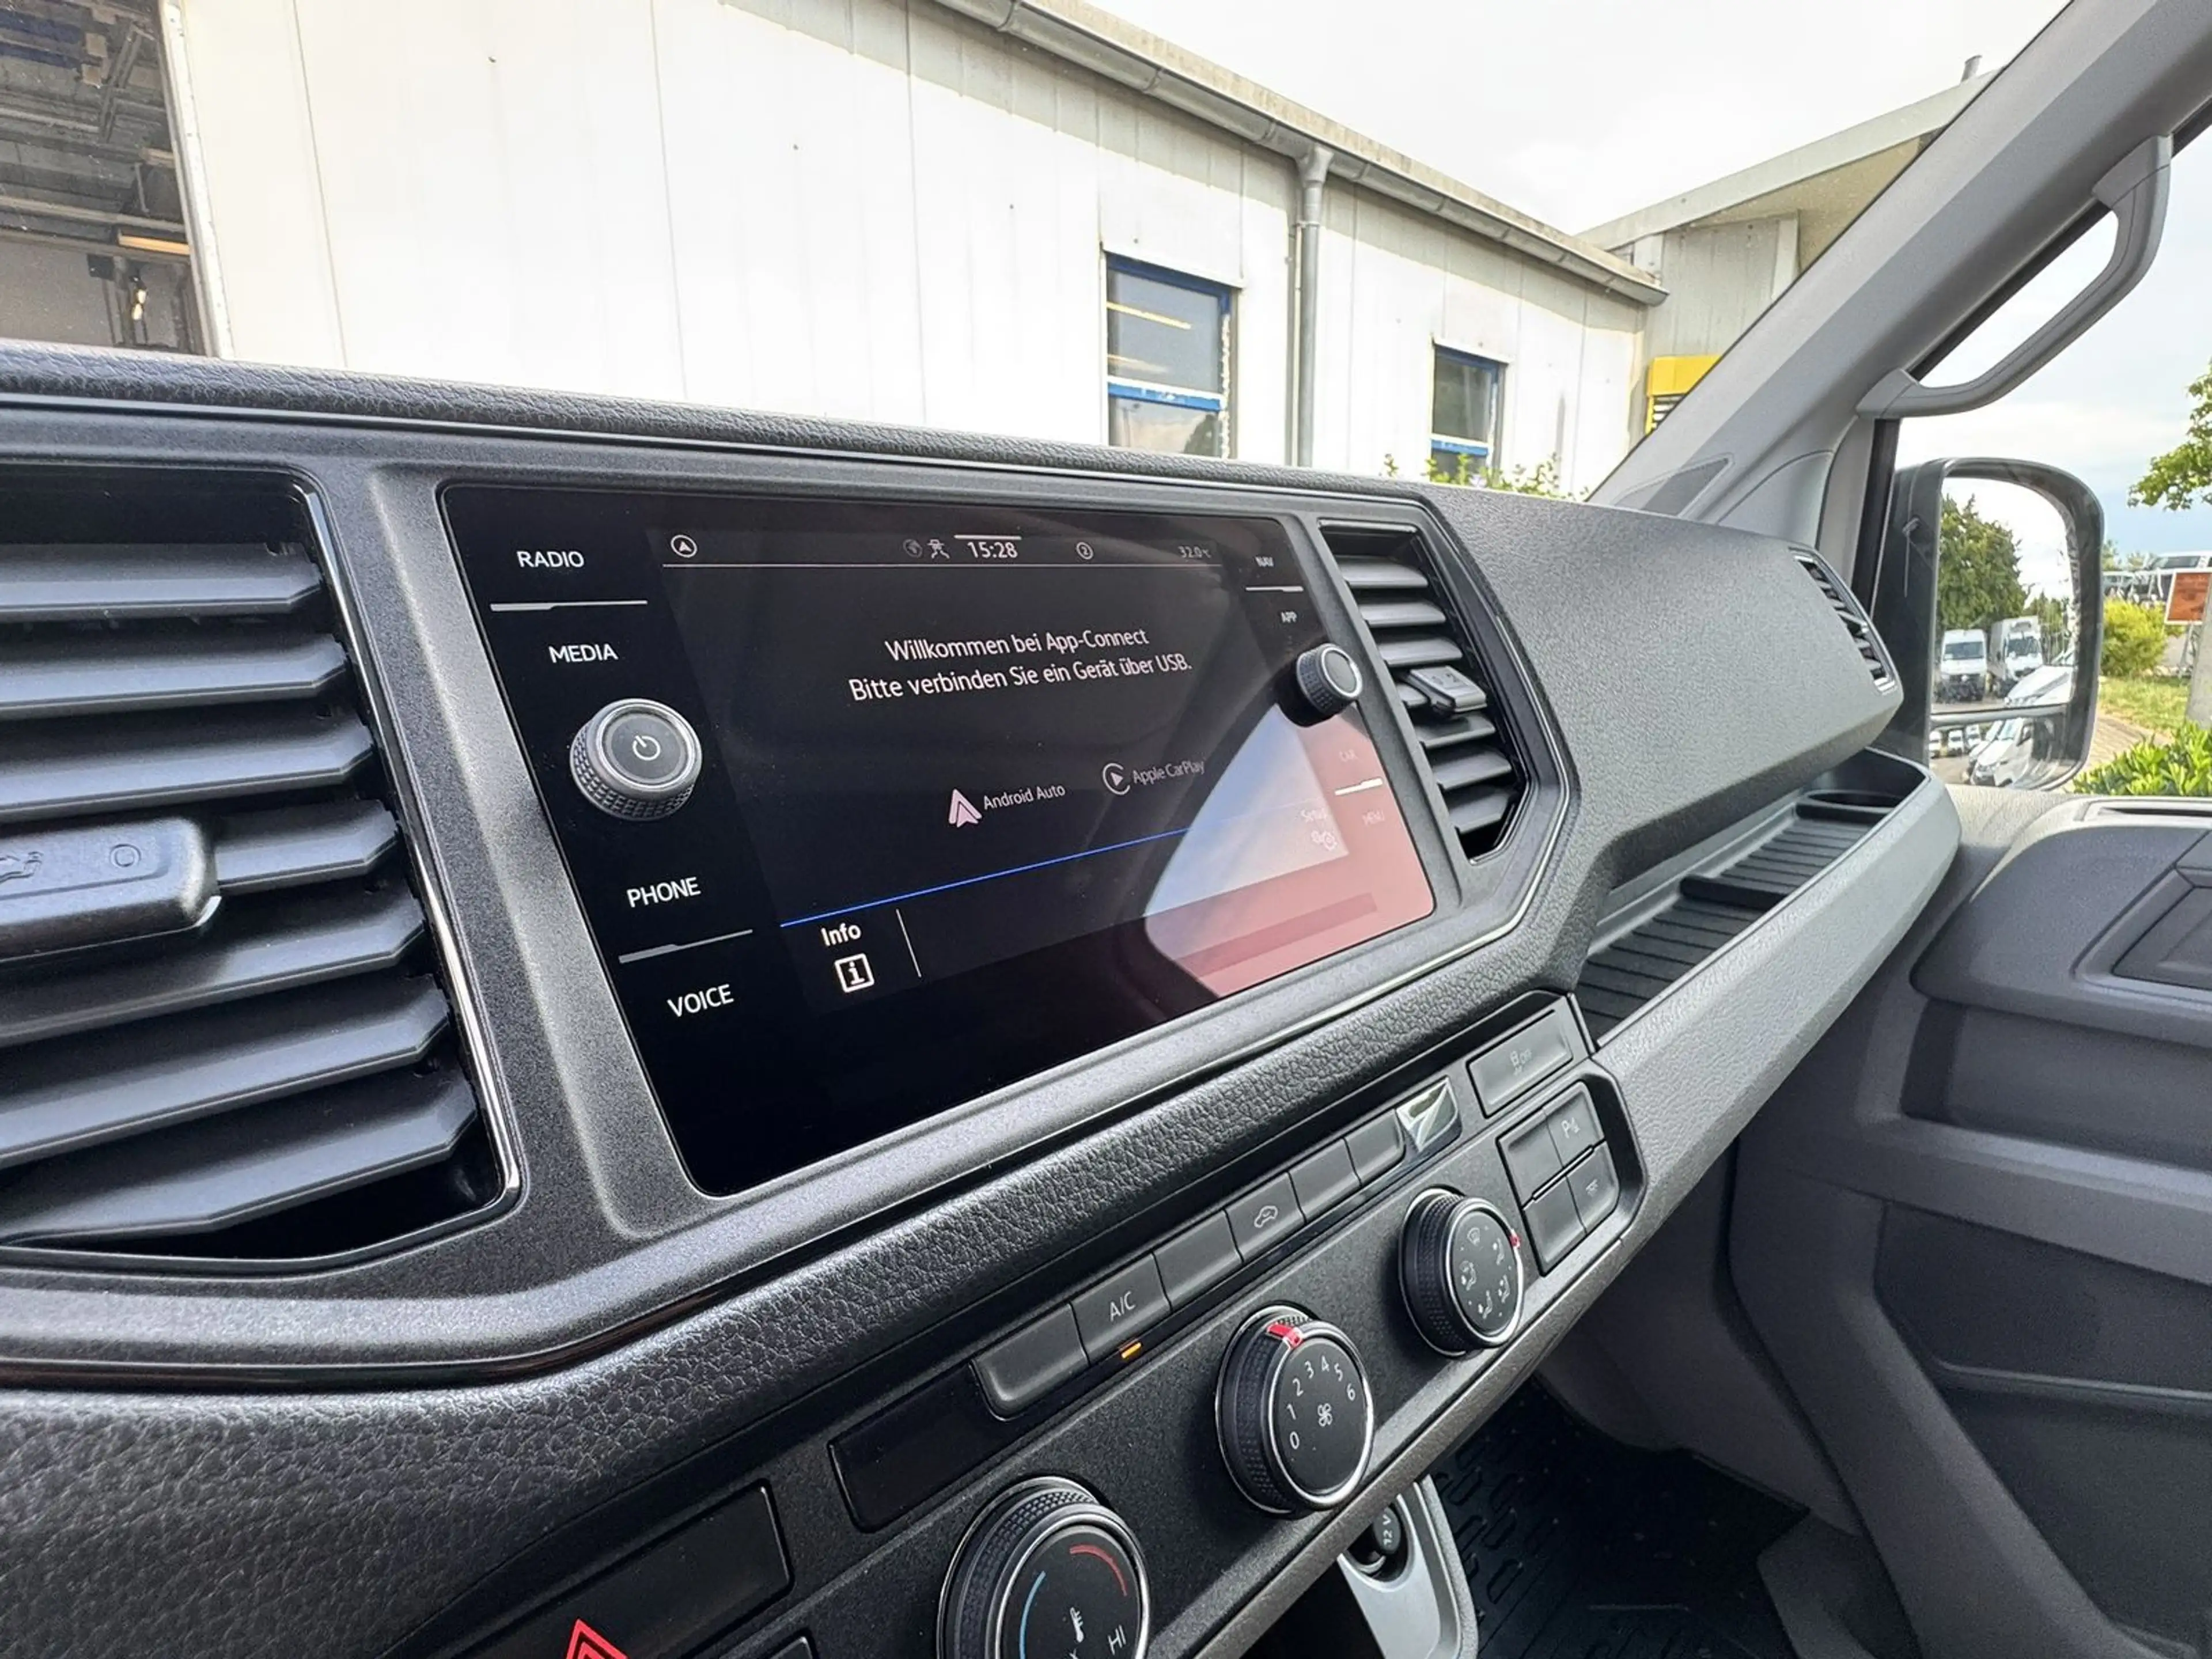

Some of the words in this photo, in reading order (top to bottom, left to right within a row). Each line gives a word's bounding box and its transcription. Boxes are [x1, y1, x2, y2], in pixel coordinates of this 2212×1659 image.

[968, 542, 1018, 558] 15:28
[517, 551, 584, 569] RADIO
[549, 644, 618, 663] MEDIA
[884, 638, 1010, 661] Willkommen
[1014, 633, 1043, 652] bei
[1046, 628, 1150, 654] App-Connect
[849, 677, 903, 701] Bitte
[907, 667, 1008, 695] verbinden
[1010, 666, 1039, 685] Sie
[1043, 663, 1071, 682] ein
[1074, 659, 1118, 679] Gerät
[1120, 656, 1154, 675] über
[1156, 653, 1192, 672] USB.
[1132, 766, 1165, 784] Apple
[1165, 760, 1205, 778] CarPlay
[983, 787, 1033, 810] Android
[1037, 784, 1065, 800] Auto
[626, 877, 701, 907] PHONE
[820, 923, 862, 946] Info
[667, 983, 734, 1017] VOICE
[1110, 1291, 1135, 1323] A/C
[1305, 1361, 1314, 1378] 3
[1321, 1355, 1330, 1372] 4
[1334, 1363, 1343, 1381] 5
[1293, 1378, 1304, 1396] 2
[1346, 1384, 1355, 1401] 6
[1287, 1404, 1296, 1420] 1
[1290, 1431, 1300, 1449] 0
[1382, 1514, 1392, 1525] V
[1383, 1529, 1392, 1546] 12
[1107, 1624, 1127, 1656] HI
